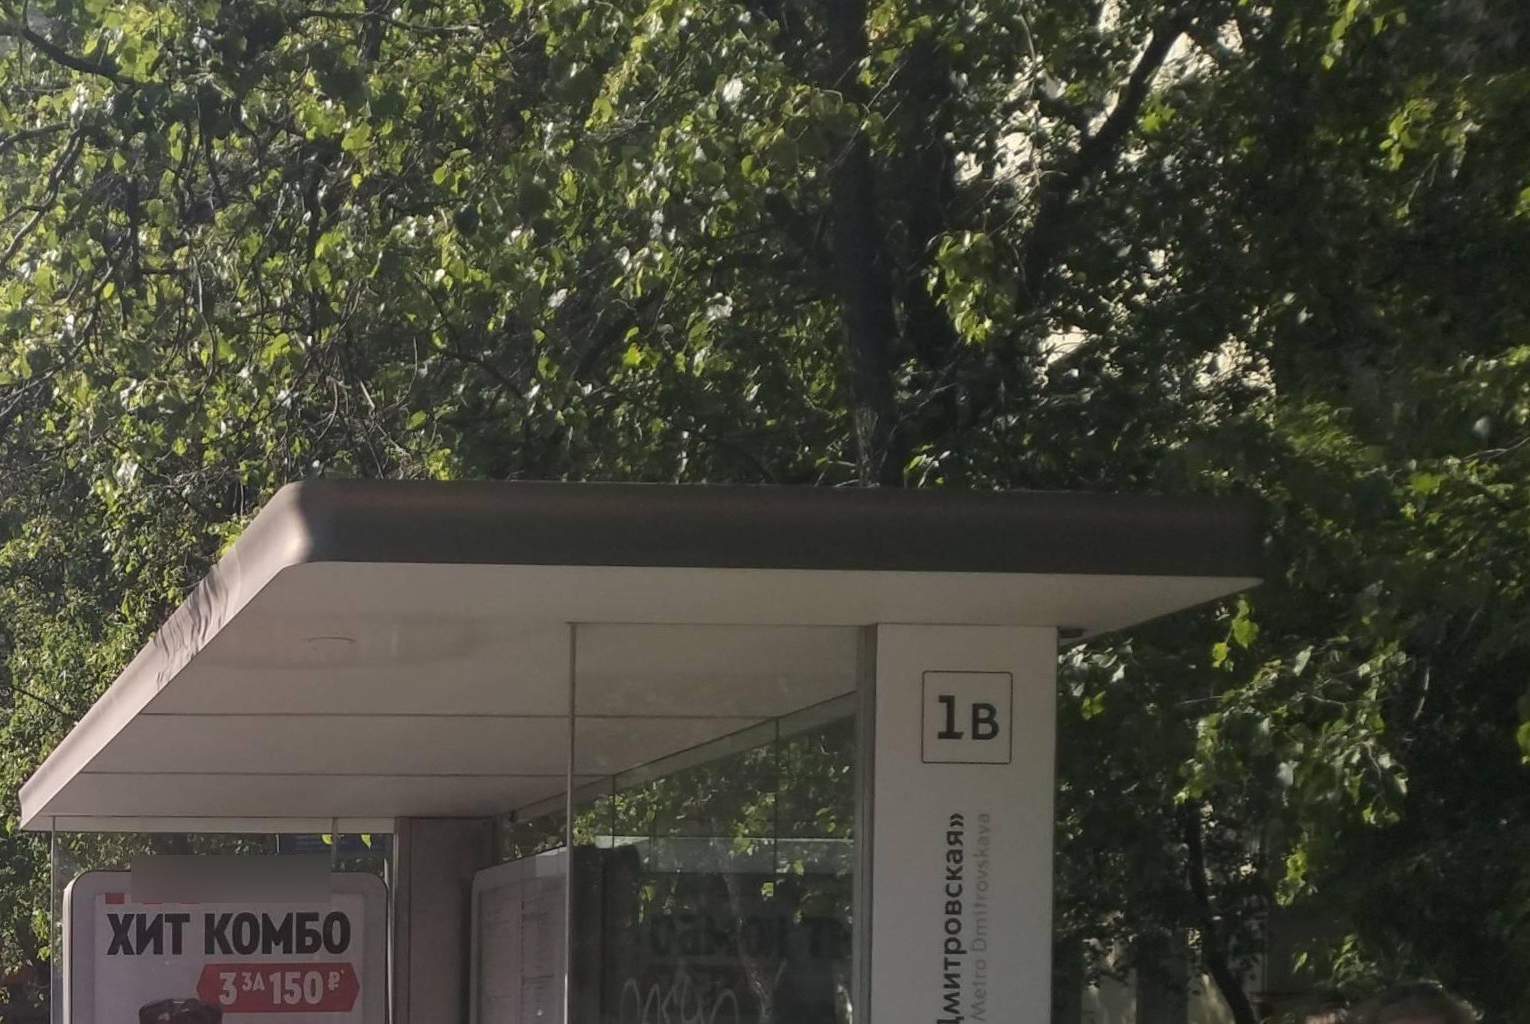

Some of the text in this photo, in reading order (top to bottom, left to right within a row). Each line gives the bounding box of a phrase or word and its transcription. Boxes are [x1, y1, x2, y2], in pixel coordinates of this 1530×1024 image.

[106, 911, 352, 956] ХИТ КОМБО
[970, 813, 991, 1022] Metro Dmitrovskaya
